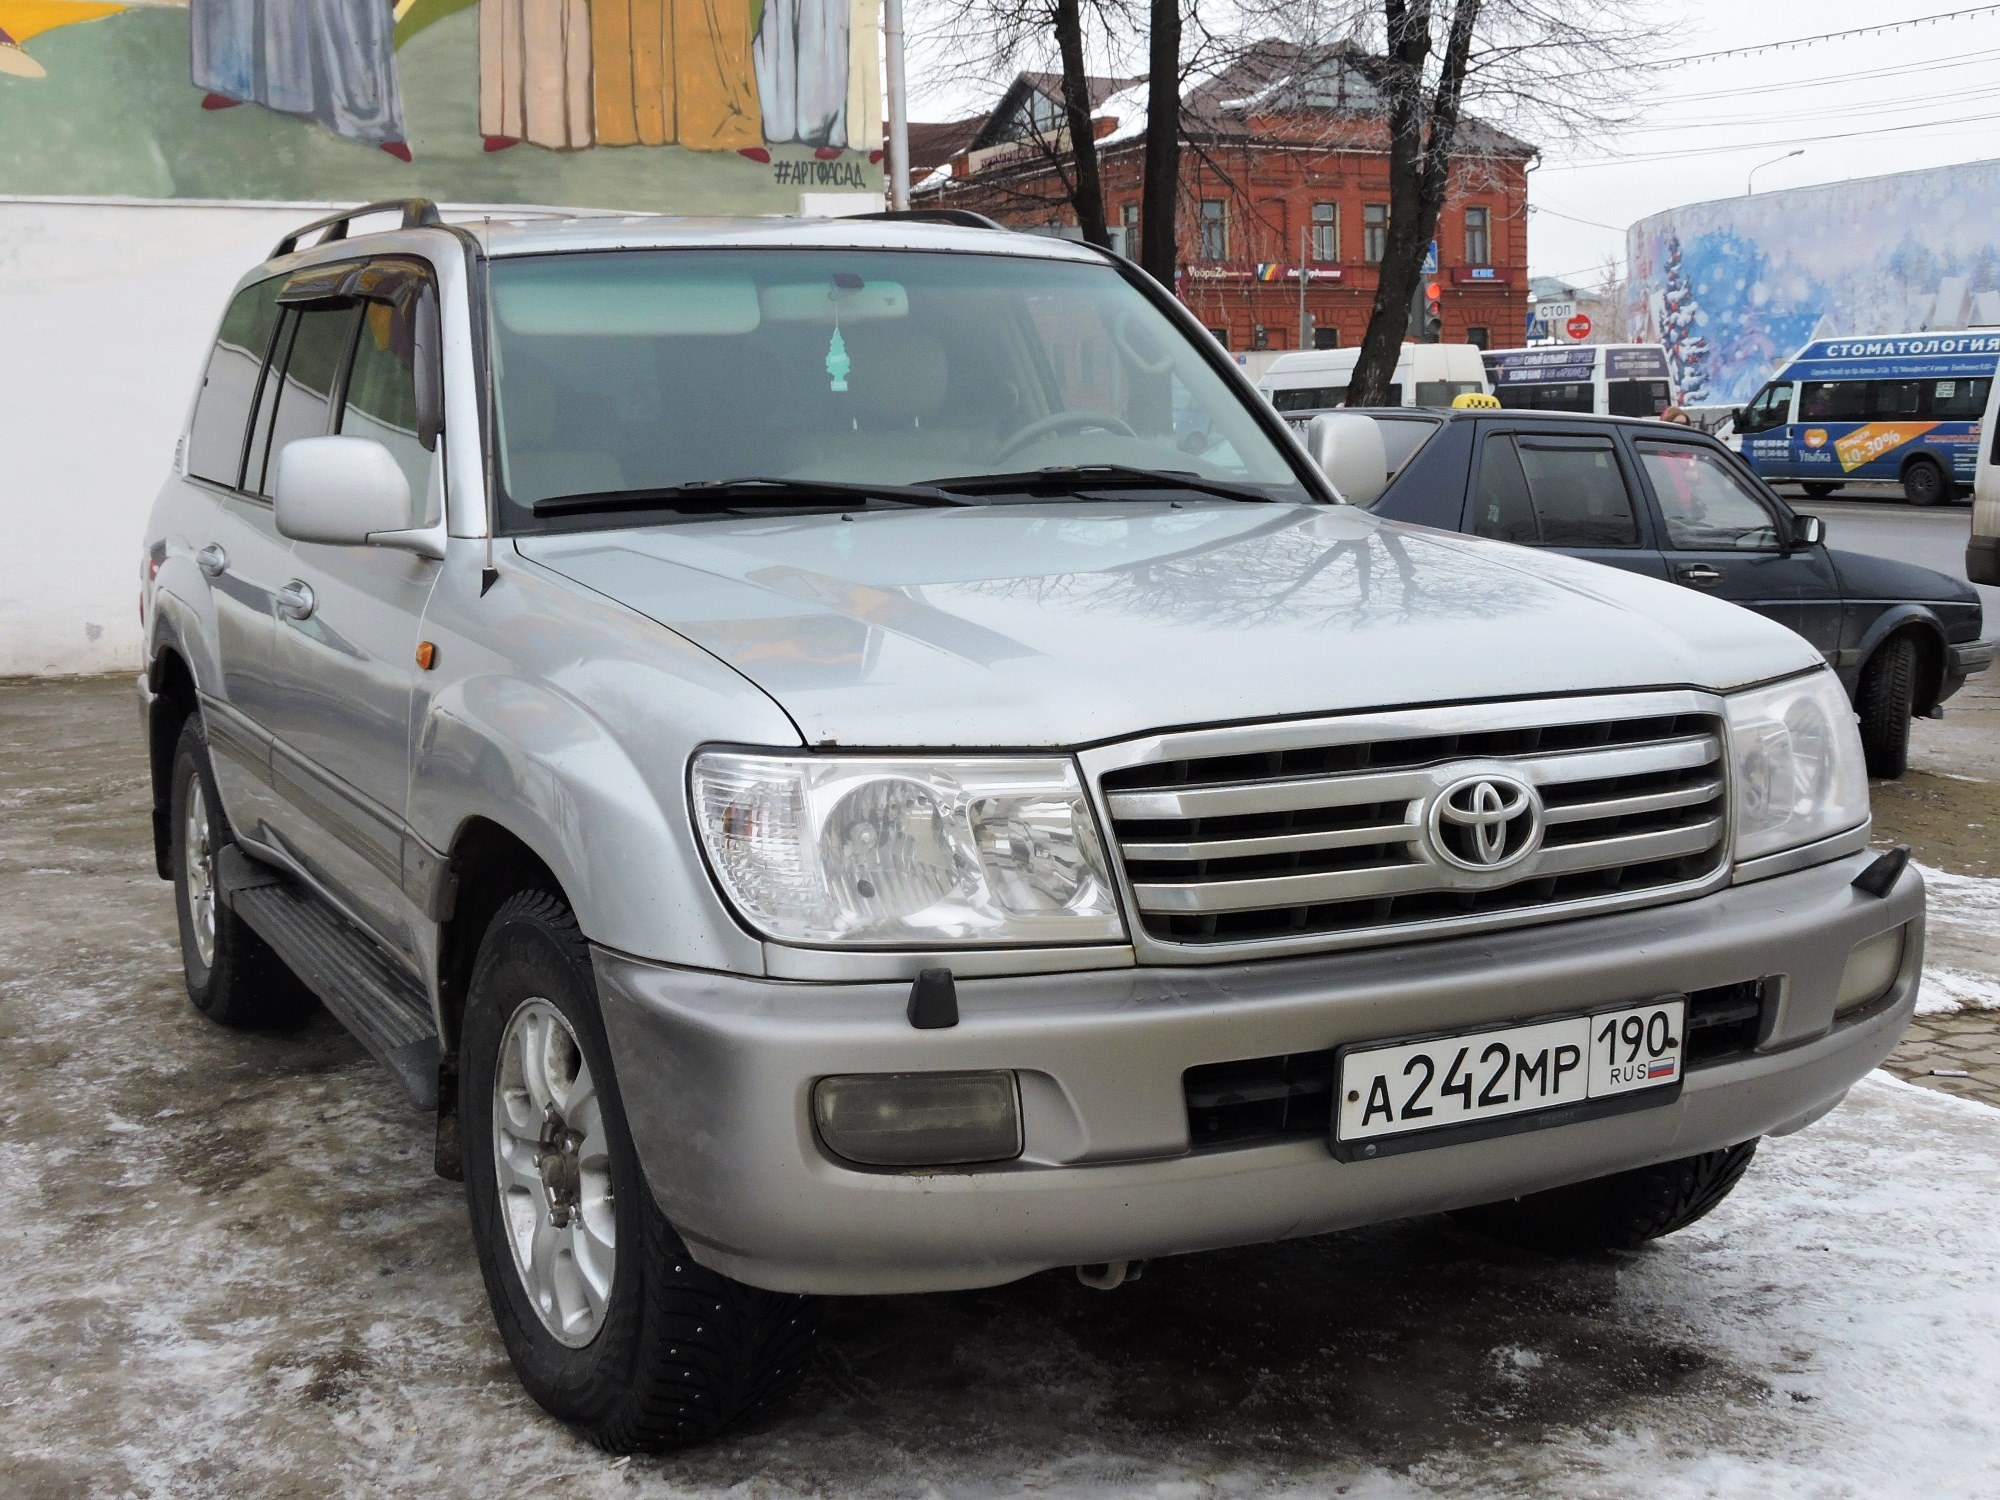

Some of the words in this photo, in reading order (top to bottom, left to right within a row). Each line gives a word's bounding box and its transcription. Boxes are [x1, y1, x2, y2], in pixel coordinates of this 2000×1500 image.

[773, 160, 866, 189] #АРТФАСАД
[1541, 305, 1571, 318] СТОП
[1826, 338, 2000, 357] СТОМАТОЛОГИЯ
[1799, 450, 1831, 462] Улыбка
[1597, 1010, 1671, 1066] 190
[1610, 1063, 1647, 1085] RUS
